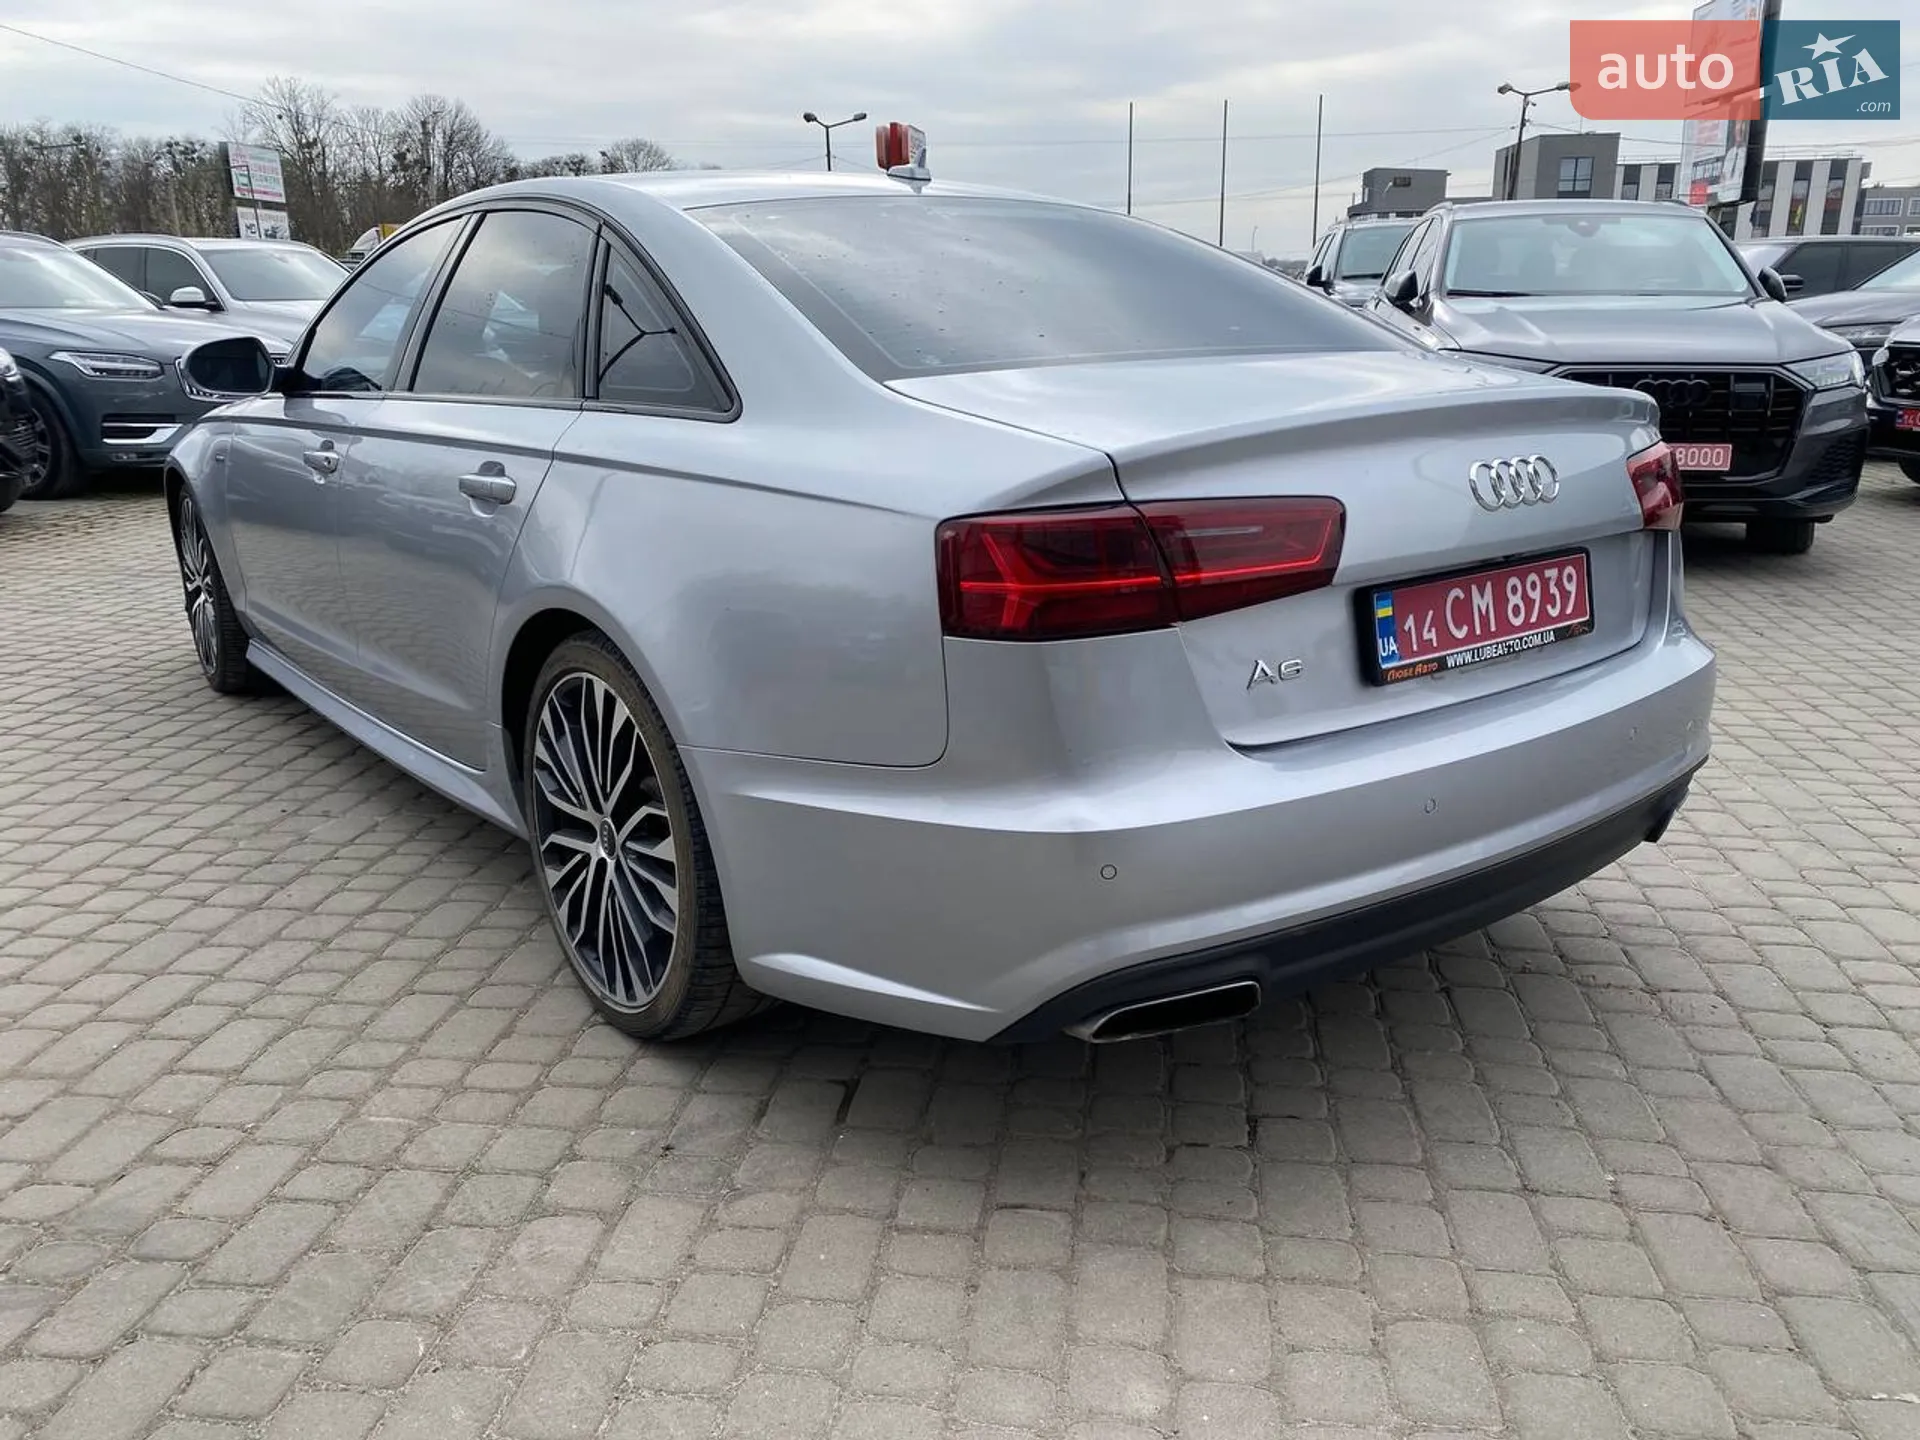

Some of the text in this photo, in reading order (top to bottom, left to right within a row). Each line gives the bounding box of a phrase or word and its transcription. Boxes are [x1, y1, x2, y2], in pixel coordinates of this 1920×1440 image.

[1675, 447, 1724, 467] 8000
[1403, 565, 1578, 652] 14 CM 8939
[1378, 637, 1398, 657] UA
[1246, 658, 1304, 690] A6
